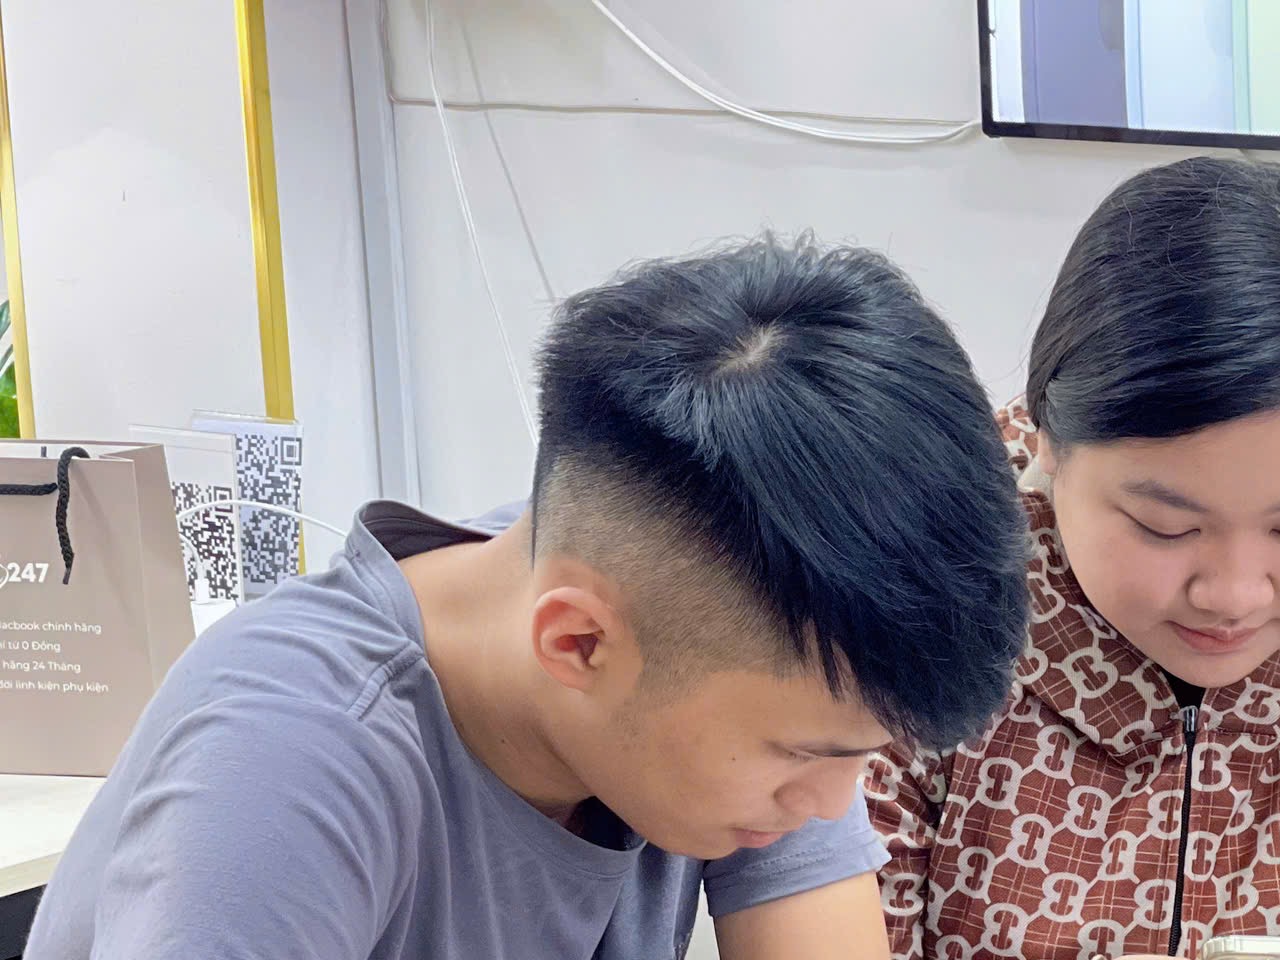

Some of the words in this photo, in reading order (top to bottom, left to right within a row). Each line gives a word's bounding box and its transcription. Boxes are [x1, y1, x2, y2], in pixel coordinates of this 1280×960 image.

[8, 562, 49, 583] 247
[32, 661, 45, 670] 24
[15, 680, 35, 690] linh
